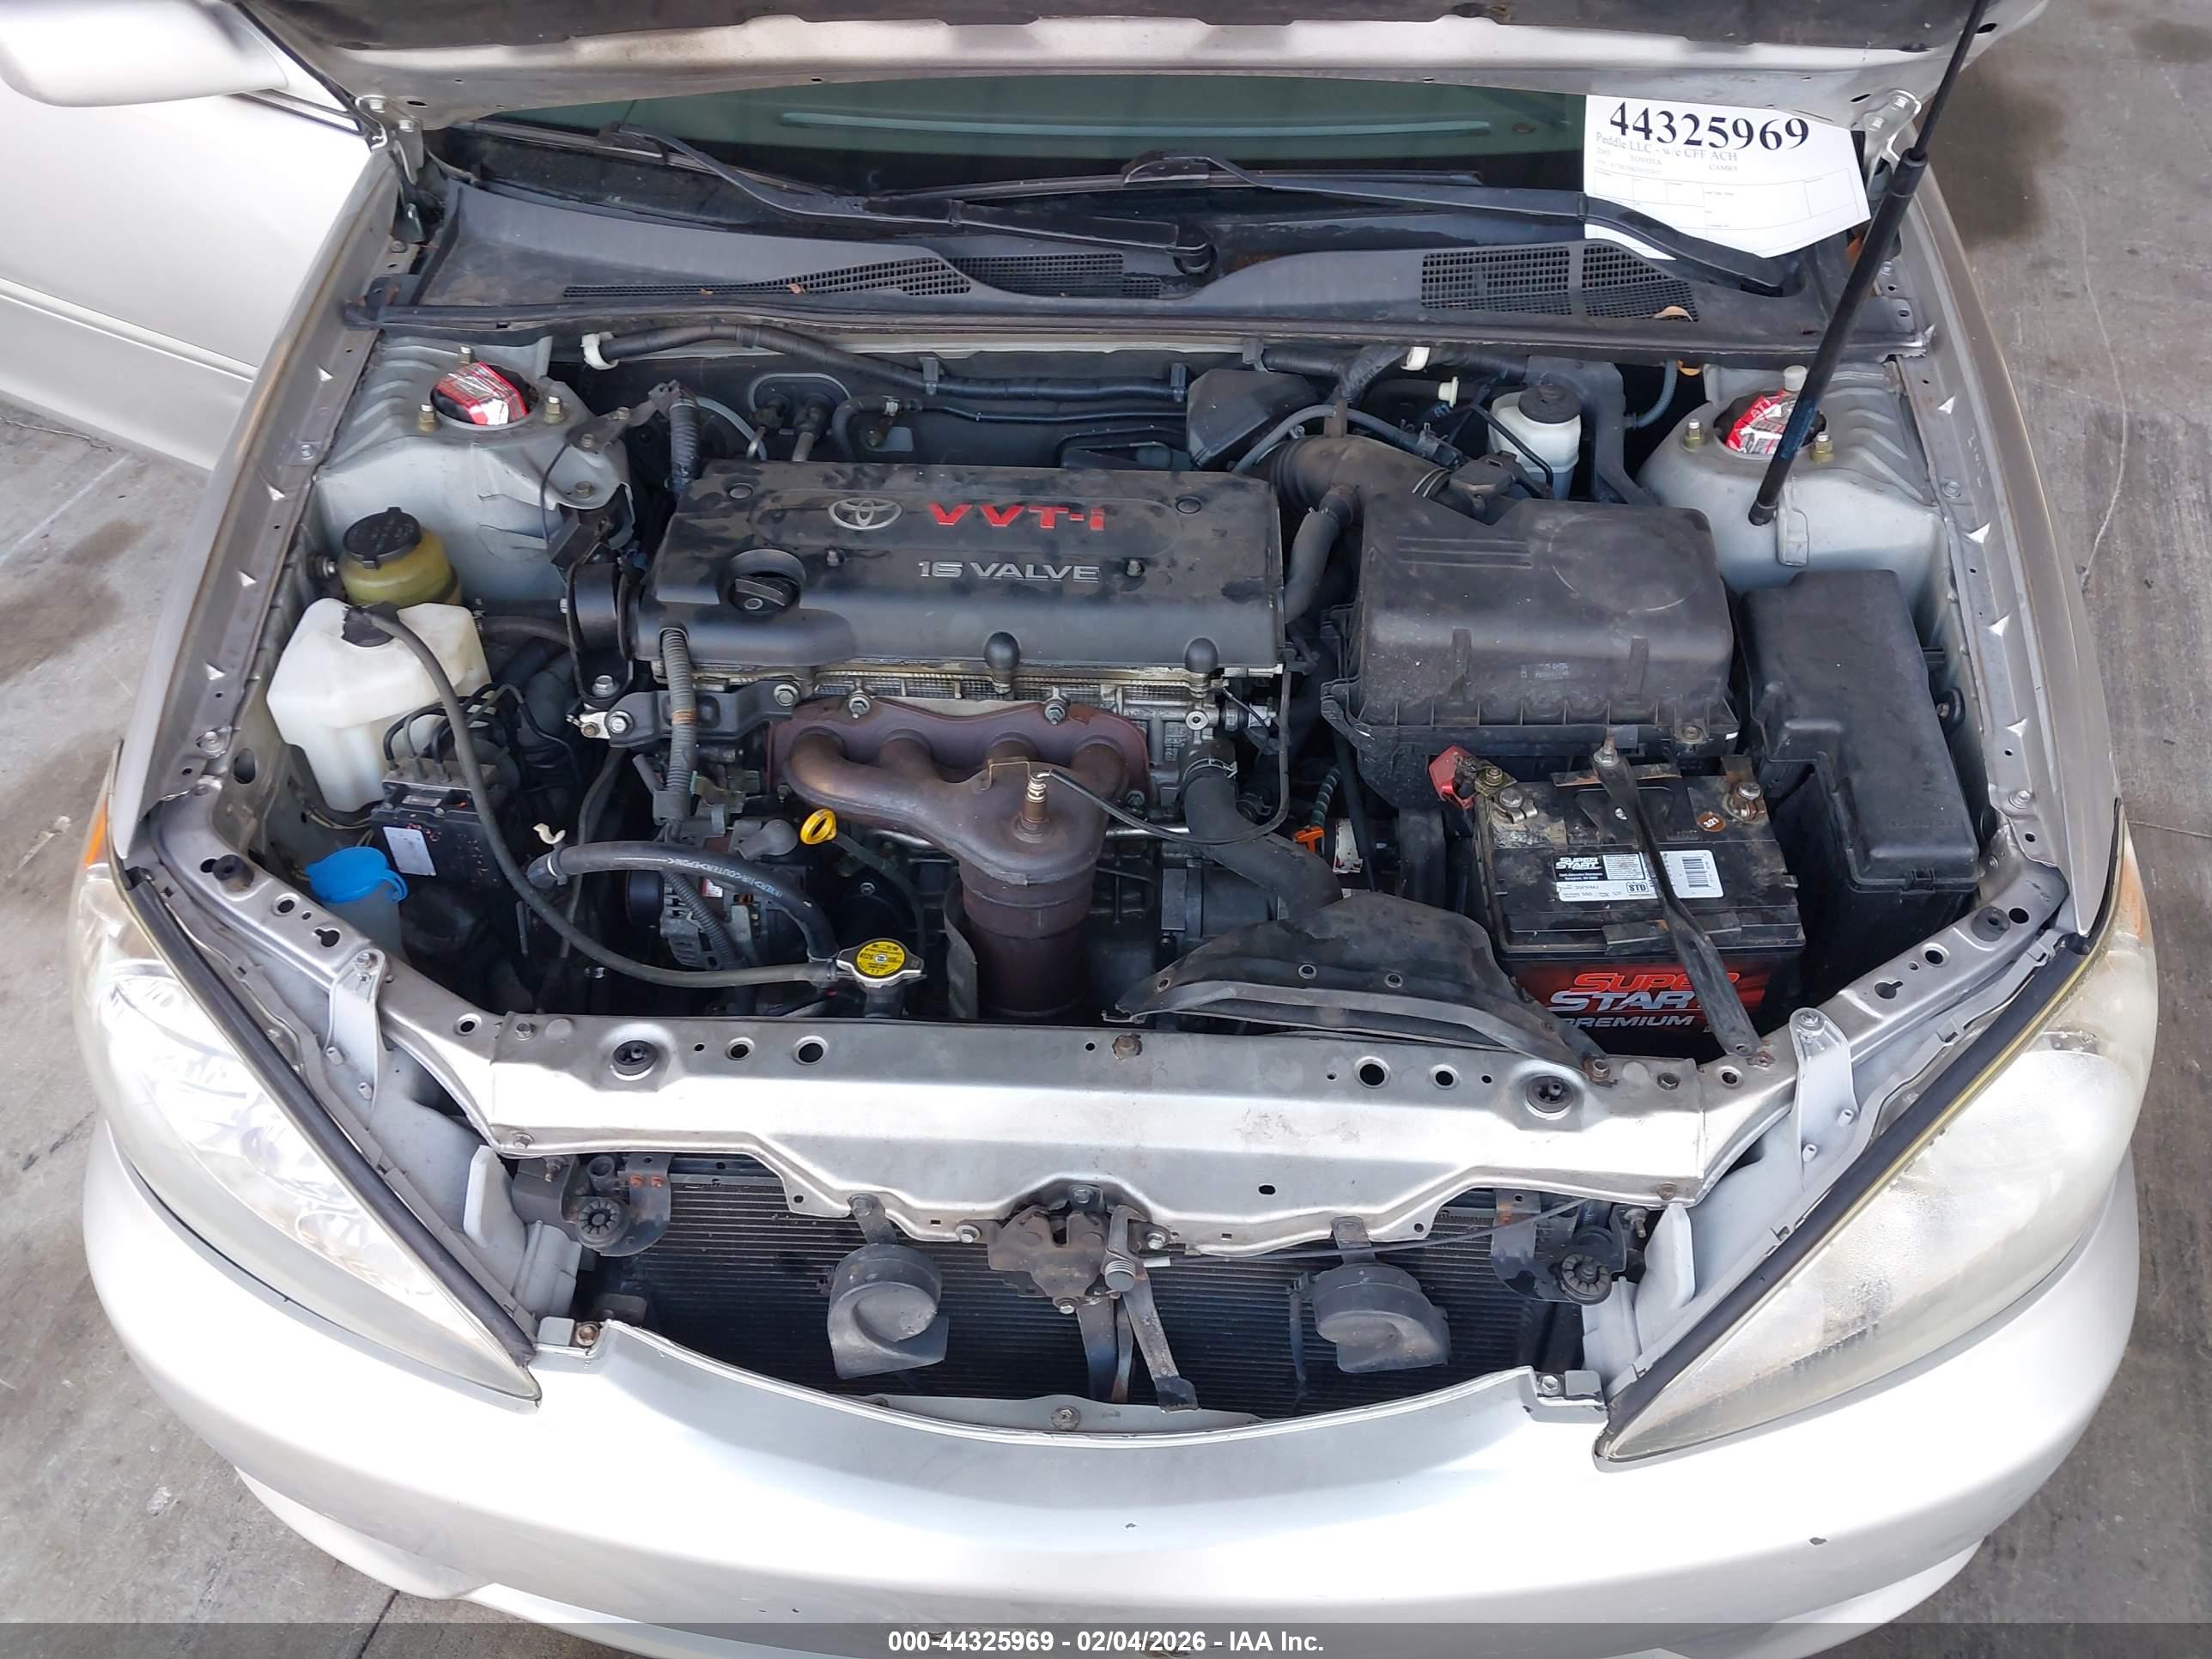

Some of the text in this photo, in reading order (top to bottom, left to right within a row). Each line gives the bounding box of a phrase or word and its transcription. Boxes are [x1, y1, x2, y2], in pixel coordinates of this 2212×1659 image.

[1610, 101, 1809, 151] 44325969
[1630, 141, 1653, 154] LLC
[1711, 150, 1738, 161] ACH
[928, 501, 1105, 532] VVT-i
[918, 561, 1100, 583] 16 VALVE
[1628, 884, 1647, 892] STD
[1548, 990, 1705, 1012] STAR
